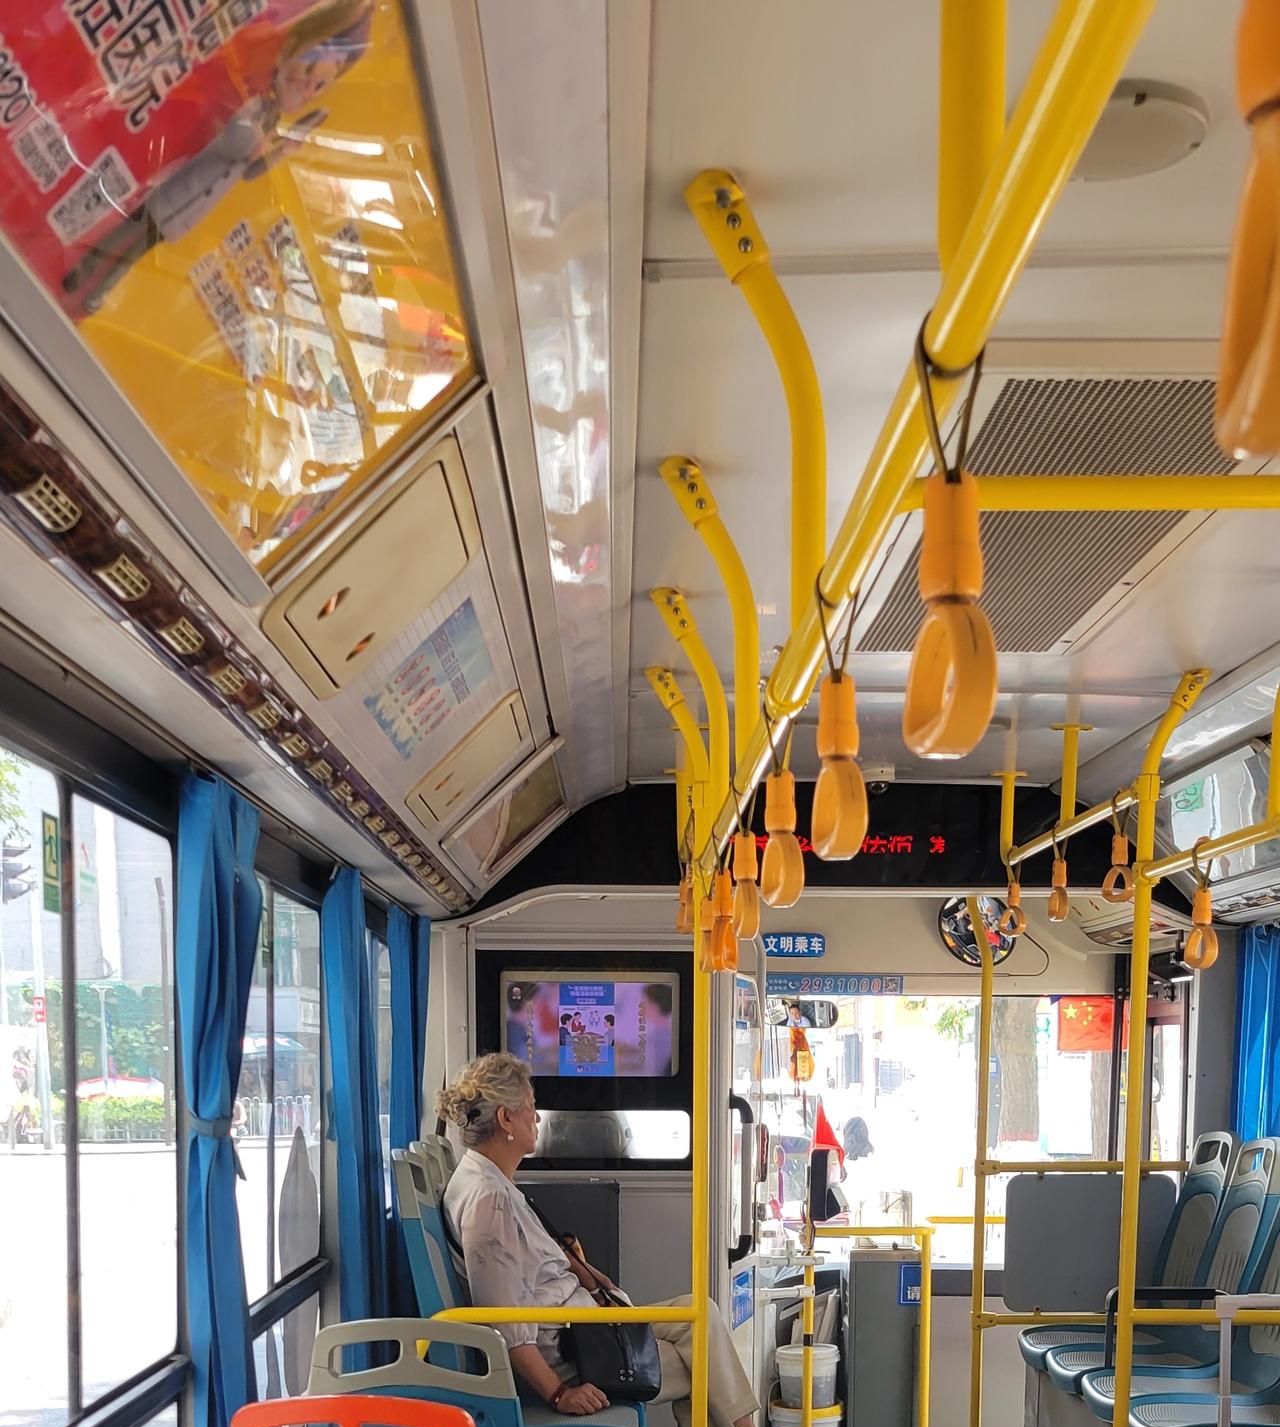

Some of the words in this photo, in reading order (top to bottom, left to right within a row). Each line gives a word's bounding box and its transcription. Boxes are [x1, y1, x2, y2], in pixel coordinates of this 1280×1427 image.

[766, 936, 823, 953] 文明乘车
[801, 977, 882, 993] 2931000
